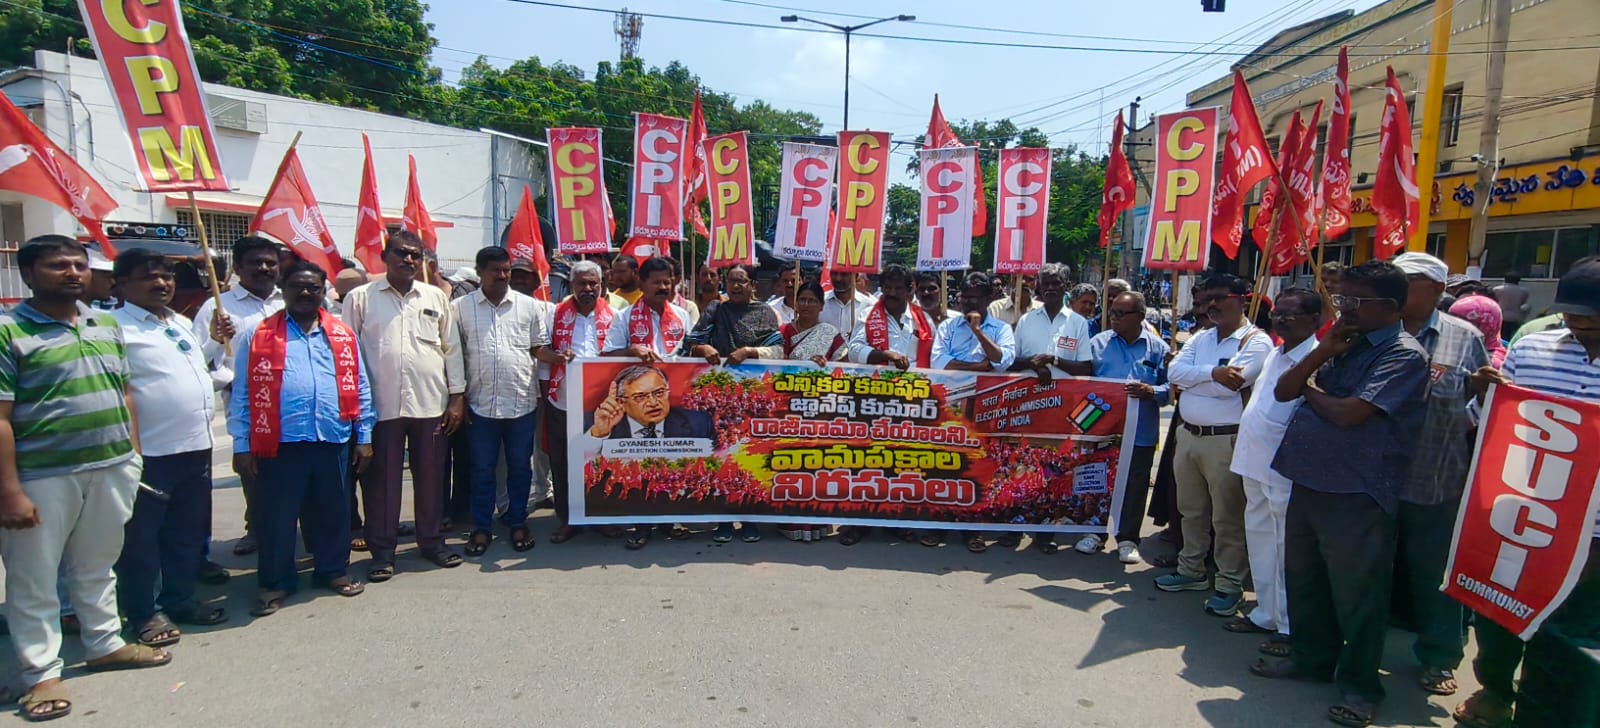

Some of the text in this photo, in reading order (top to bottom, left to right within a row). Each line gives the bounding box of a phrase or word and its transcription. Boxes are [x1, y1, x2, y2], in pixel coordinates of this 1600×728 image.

[101, 0, 217, 183] CPM
[556, 142, 596, 241] CPI
[639, 129, 680, 227] CPI
[712, 137, 749, 261] CPM
[790, 157, 829, 248] CPI
[836, 134, 881, 266] CPM
[926, 161, 964, 259] CPI
[1003, 162, 1044, 262] CPI
[1152, 117, 1205, 261] CPM
[751, 414, 869, 439] రాజీనామా
[774, 375, 932, 400] ఎన్నికల కమిషన్
[860, 398, 939, 420] కుమార్
[976, 406, 1008, 423] ELECTION
[997, 414, 1031, 430] OF INDIA
[619, 440, 660, 448] GYANESH
[771, 444, 963, 475] వామపక్షాల
[772, 469, 976, 506] నిరసనలు
[1489, 399, 1582, 592] SUCI
[1456, 573, 1535, 620] COMMUNIST
